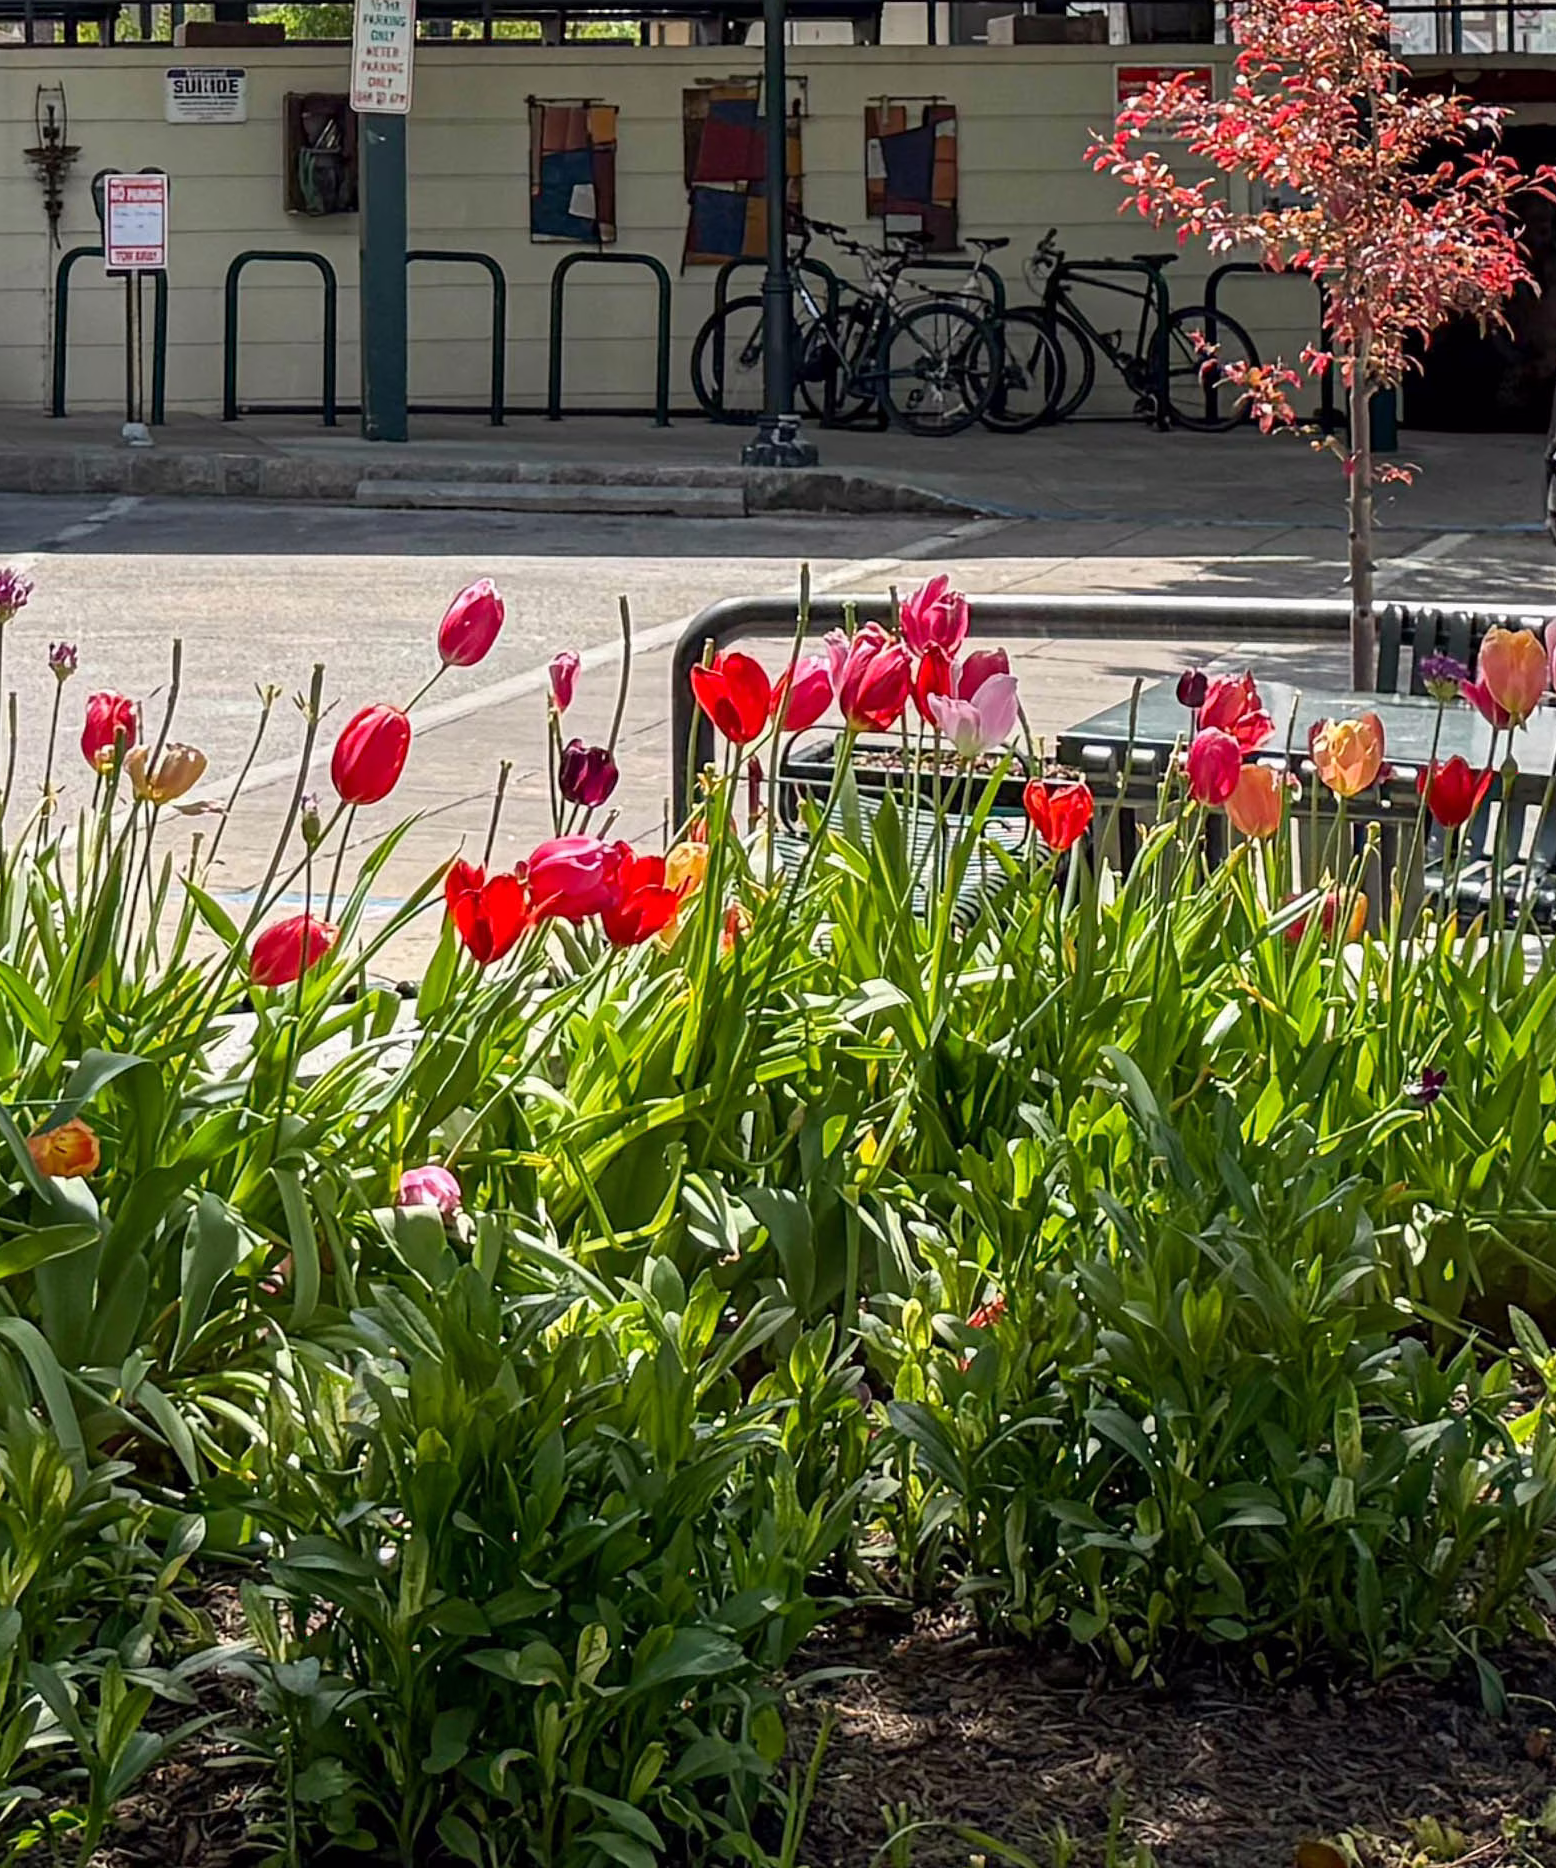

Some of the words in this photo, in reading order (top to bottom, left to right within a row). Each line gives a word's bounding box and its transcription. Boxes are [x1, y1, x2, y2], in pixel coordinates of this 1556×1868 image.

[363, 14, 407, 28] PARKING
[370, 30, 396, 42] ONLY
[361, 62, 404, 74] PARKING
[367, 77, 393, 88] ONLY
